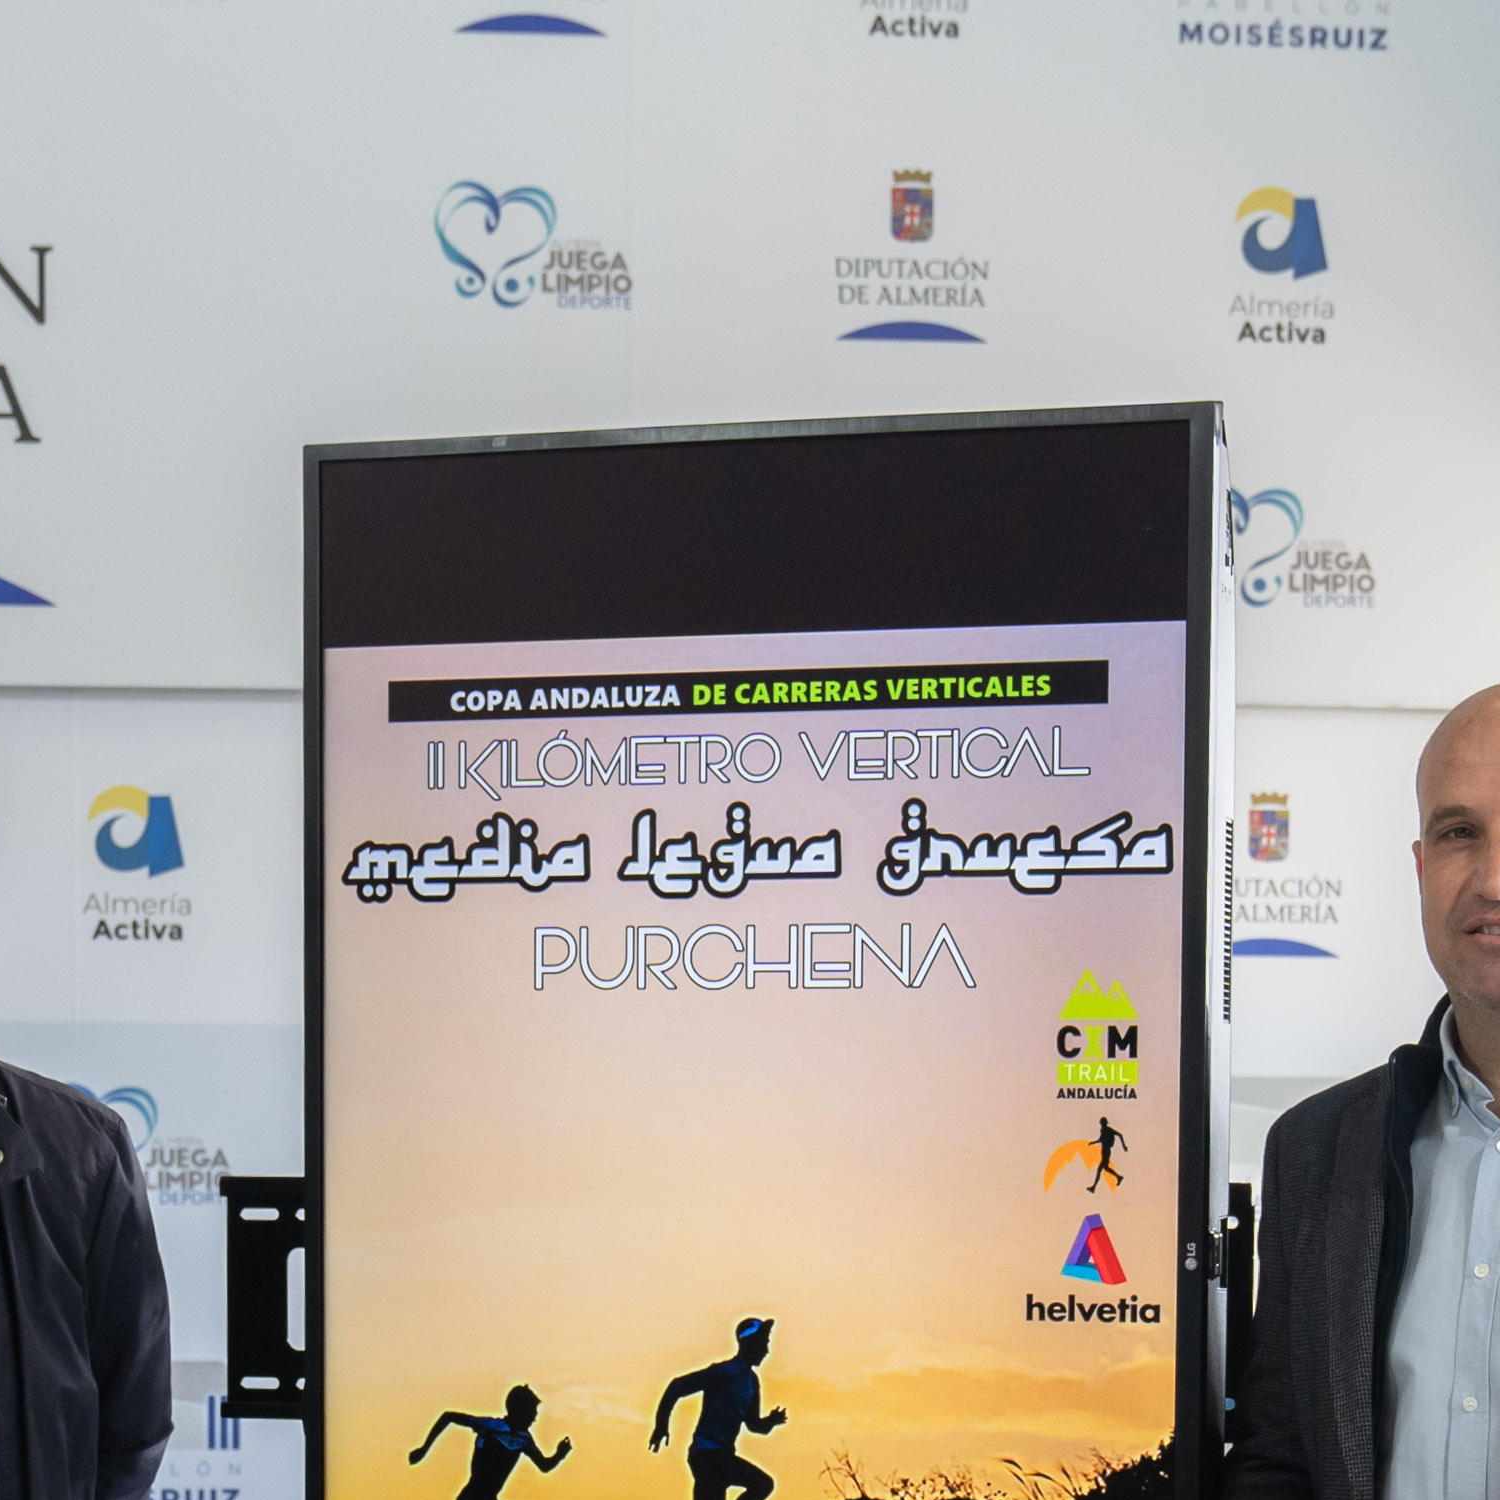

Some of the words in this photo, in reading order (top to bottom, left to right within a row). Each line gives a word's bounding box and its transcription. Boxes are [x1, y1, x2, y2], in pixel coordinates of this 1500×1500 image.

[869, 15, 960, 40] Activa
[1179, 18, 1391, 51] MOISÉSRUIZ
[543, 250, 628, 272] JUEGA
[834, 256, 989, 281] DIPUTACIÓN
[541, 272, 633, 295] LIMPIO
[837, 284, 870, 306] DE
[877, 283, 986, 308] ALMERÍA
[556, 294, 632, 311] DEPORTE
[1228, 293, 1335, 319] Almería
[1238, 320, 1326, 344] Activa
[1291, 550, 1372, 571] JUEGA
[1288, 572, 1375, 593] LIMPIO
[1303, 594, 1375, 609] DEPORTE
[450, 689, 521, 713] COPA
[530, 684, 681, 710] ANDALUZA
[693, 682, 727, 706] DE
[734, 678, 878, 704] CARRERAS
[886, 674, 1052, 702] VERTICALES
[459, 730, 782, 801] KILÓMETRO
[799, 726, 1091, 781] VERTICAL
[1234, 876, 1342, 900] UTACIÓN
[83, 891, 192, 916] Almería
[1235, 900, 1339, 925] ALMERÍA
[92, 918, 183, 941] Activa
[533, 923, 976, 991] PURCHENA
[1064, 1063, 1131, 1083] TRAIL
[1056, 1085, 1138, 1100] ANDALUCÍA
[146, 1148, 229, 1168] JUEGA
[1186, 1242, 1196, 1257] LG
[1025, 1293, 1161, 1323] helvetia
